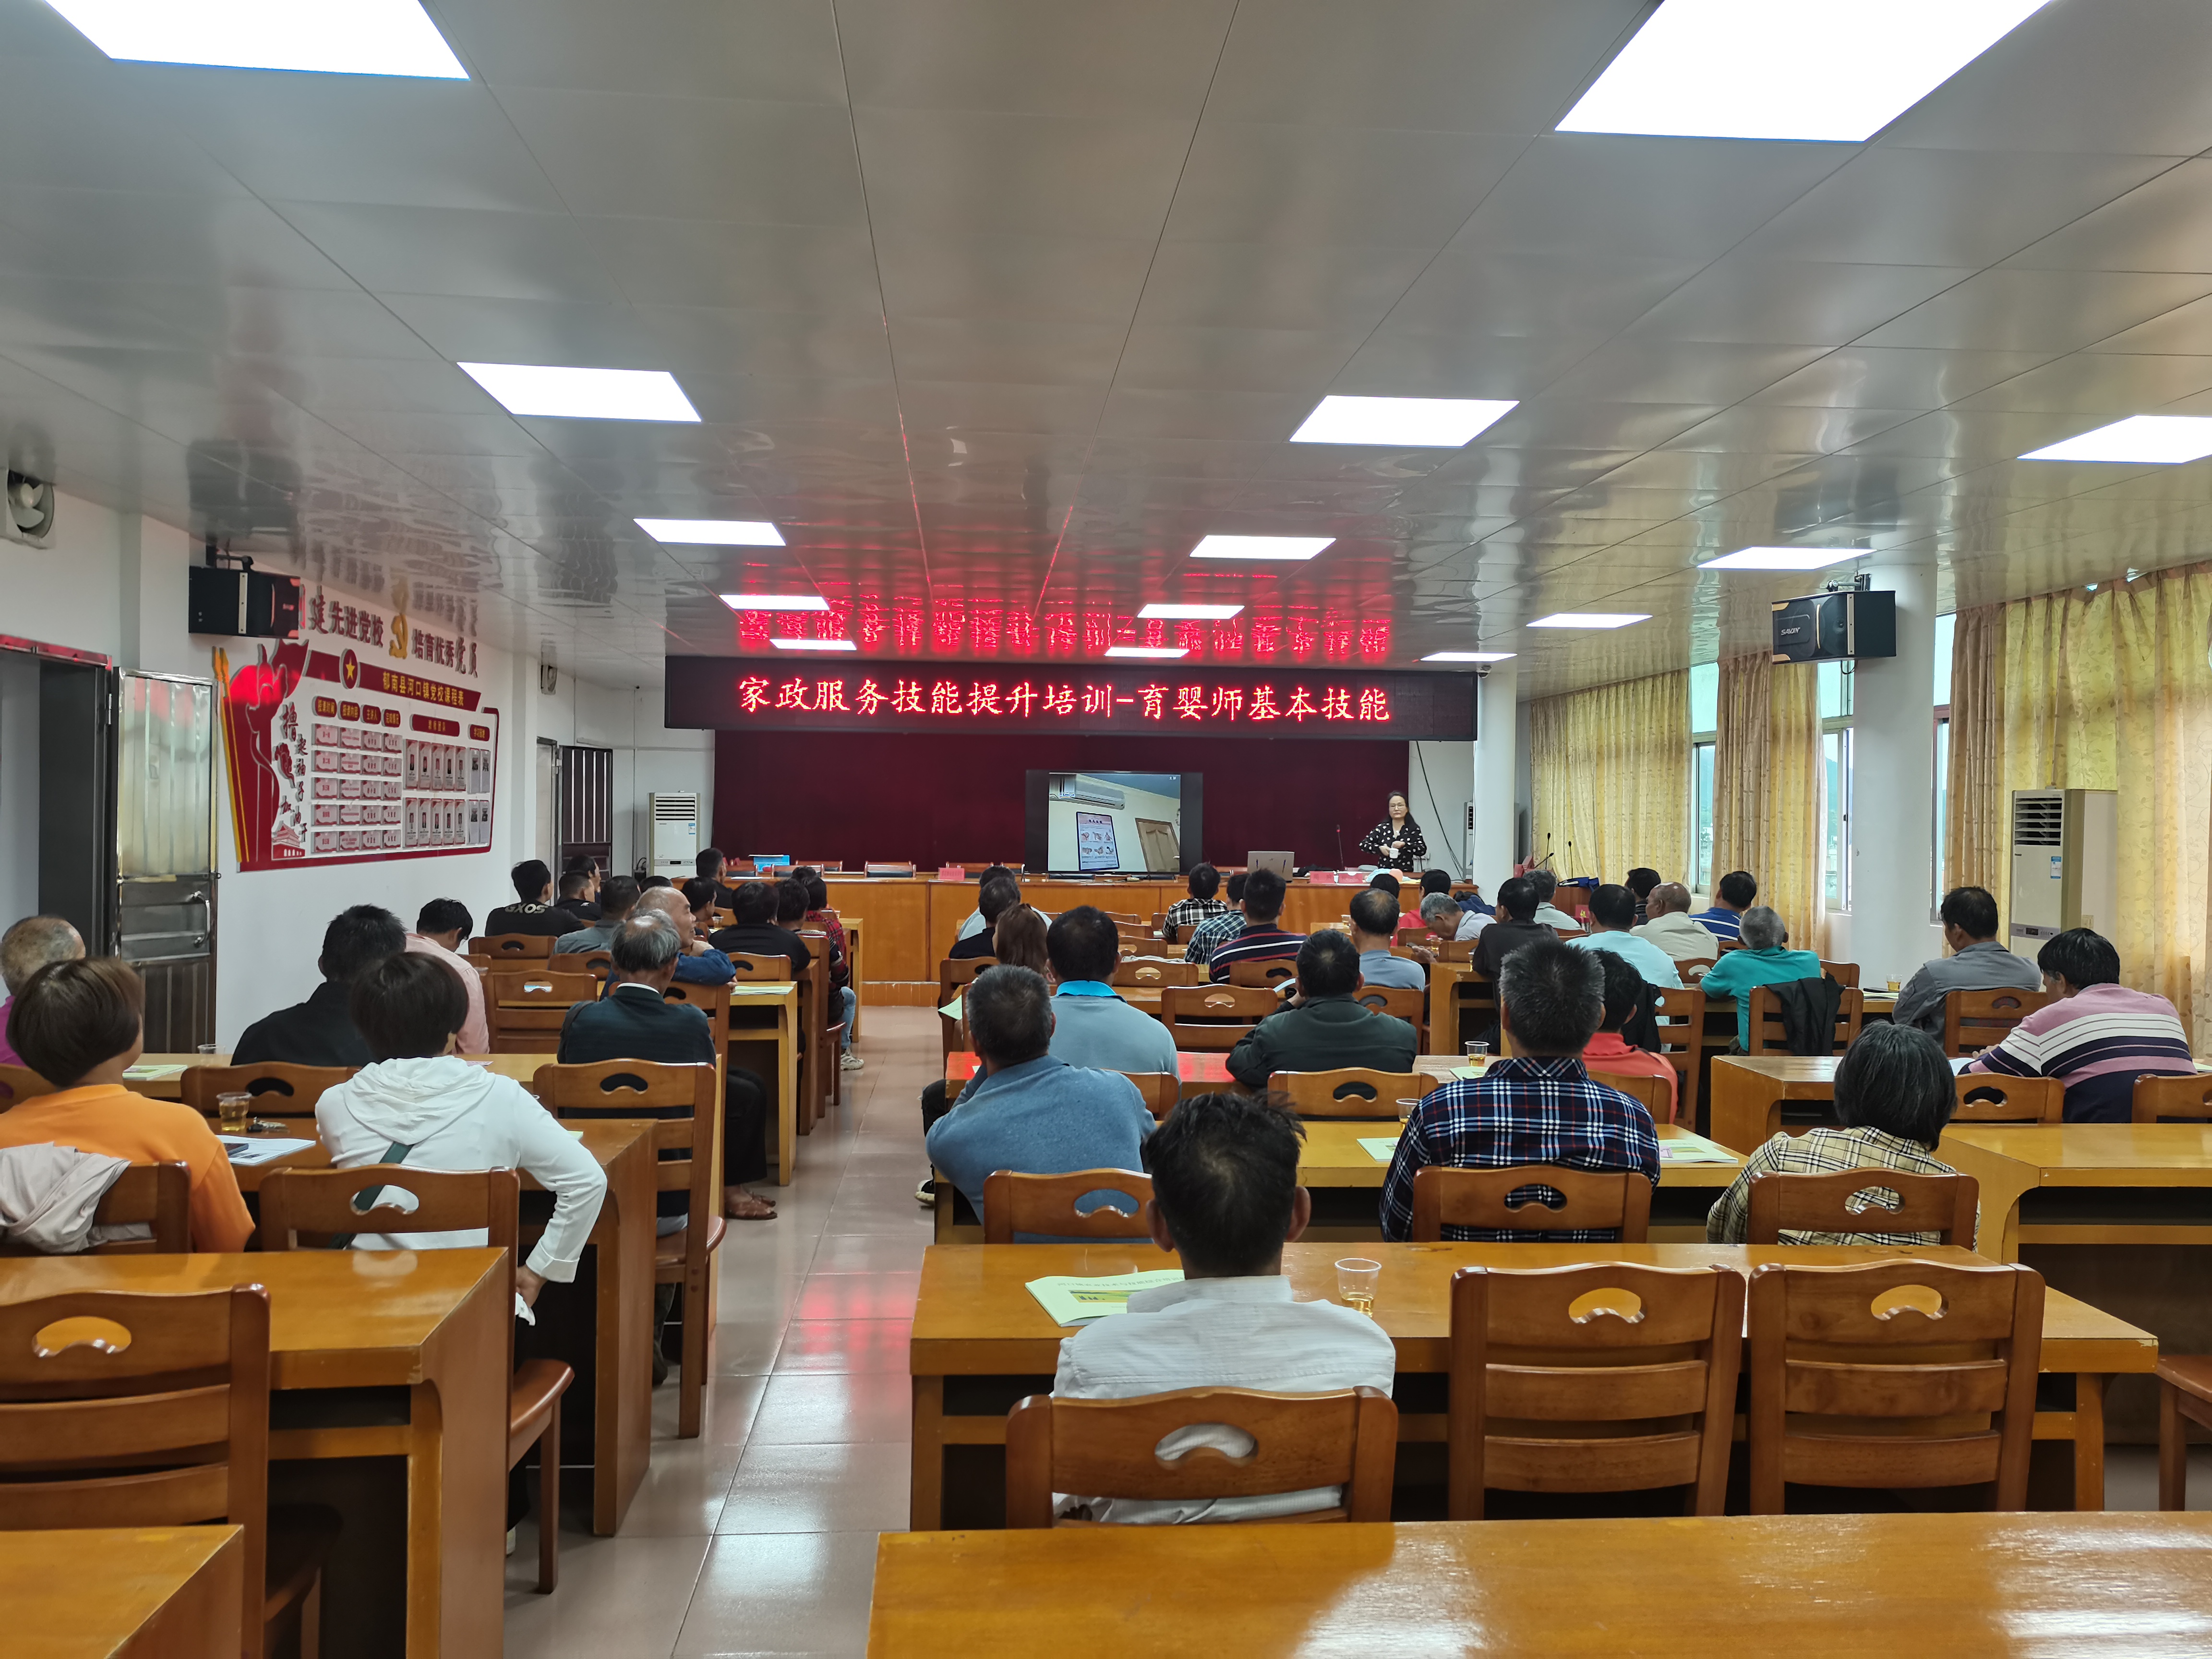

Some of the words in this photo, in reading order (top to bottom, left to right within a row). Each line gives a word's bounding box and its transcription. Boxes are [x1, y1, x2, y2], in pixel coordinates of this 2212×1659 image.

[300, 584, 384, 648] 建先进党校
[412, 629, 478, 678] 培育优秀党员
[383, 671, 464, 707] 郁南县河口镇党校课程表
[739, 677, 1390, 722] 家政服务技能提升培训-育婴师基本技能
